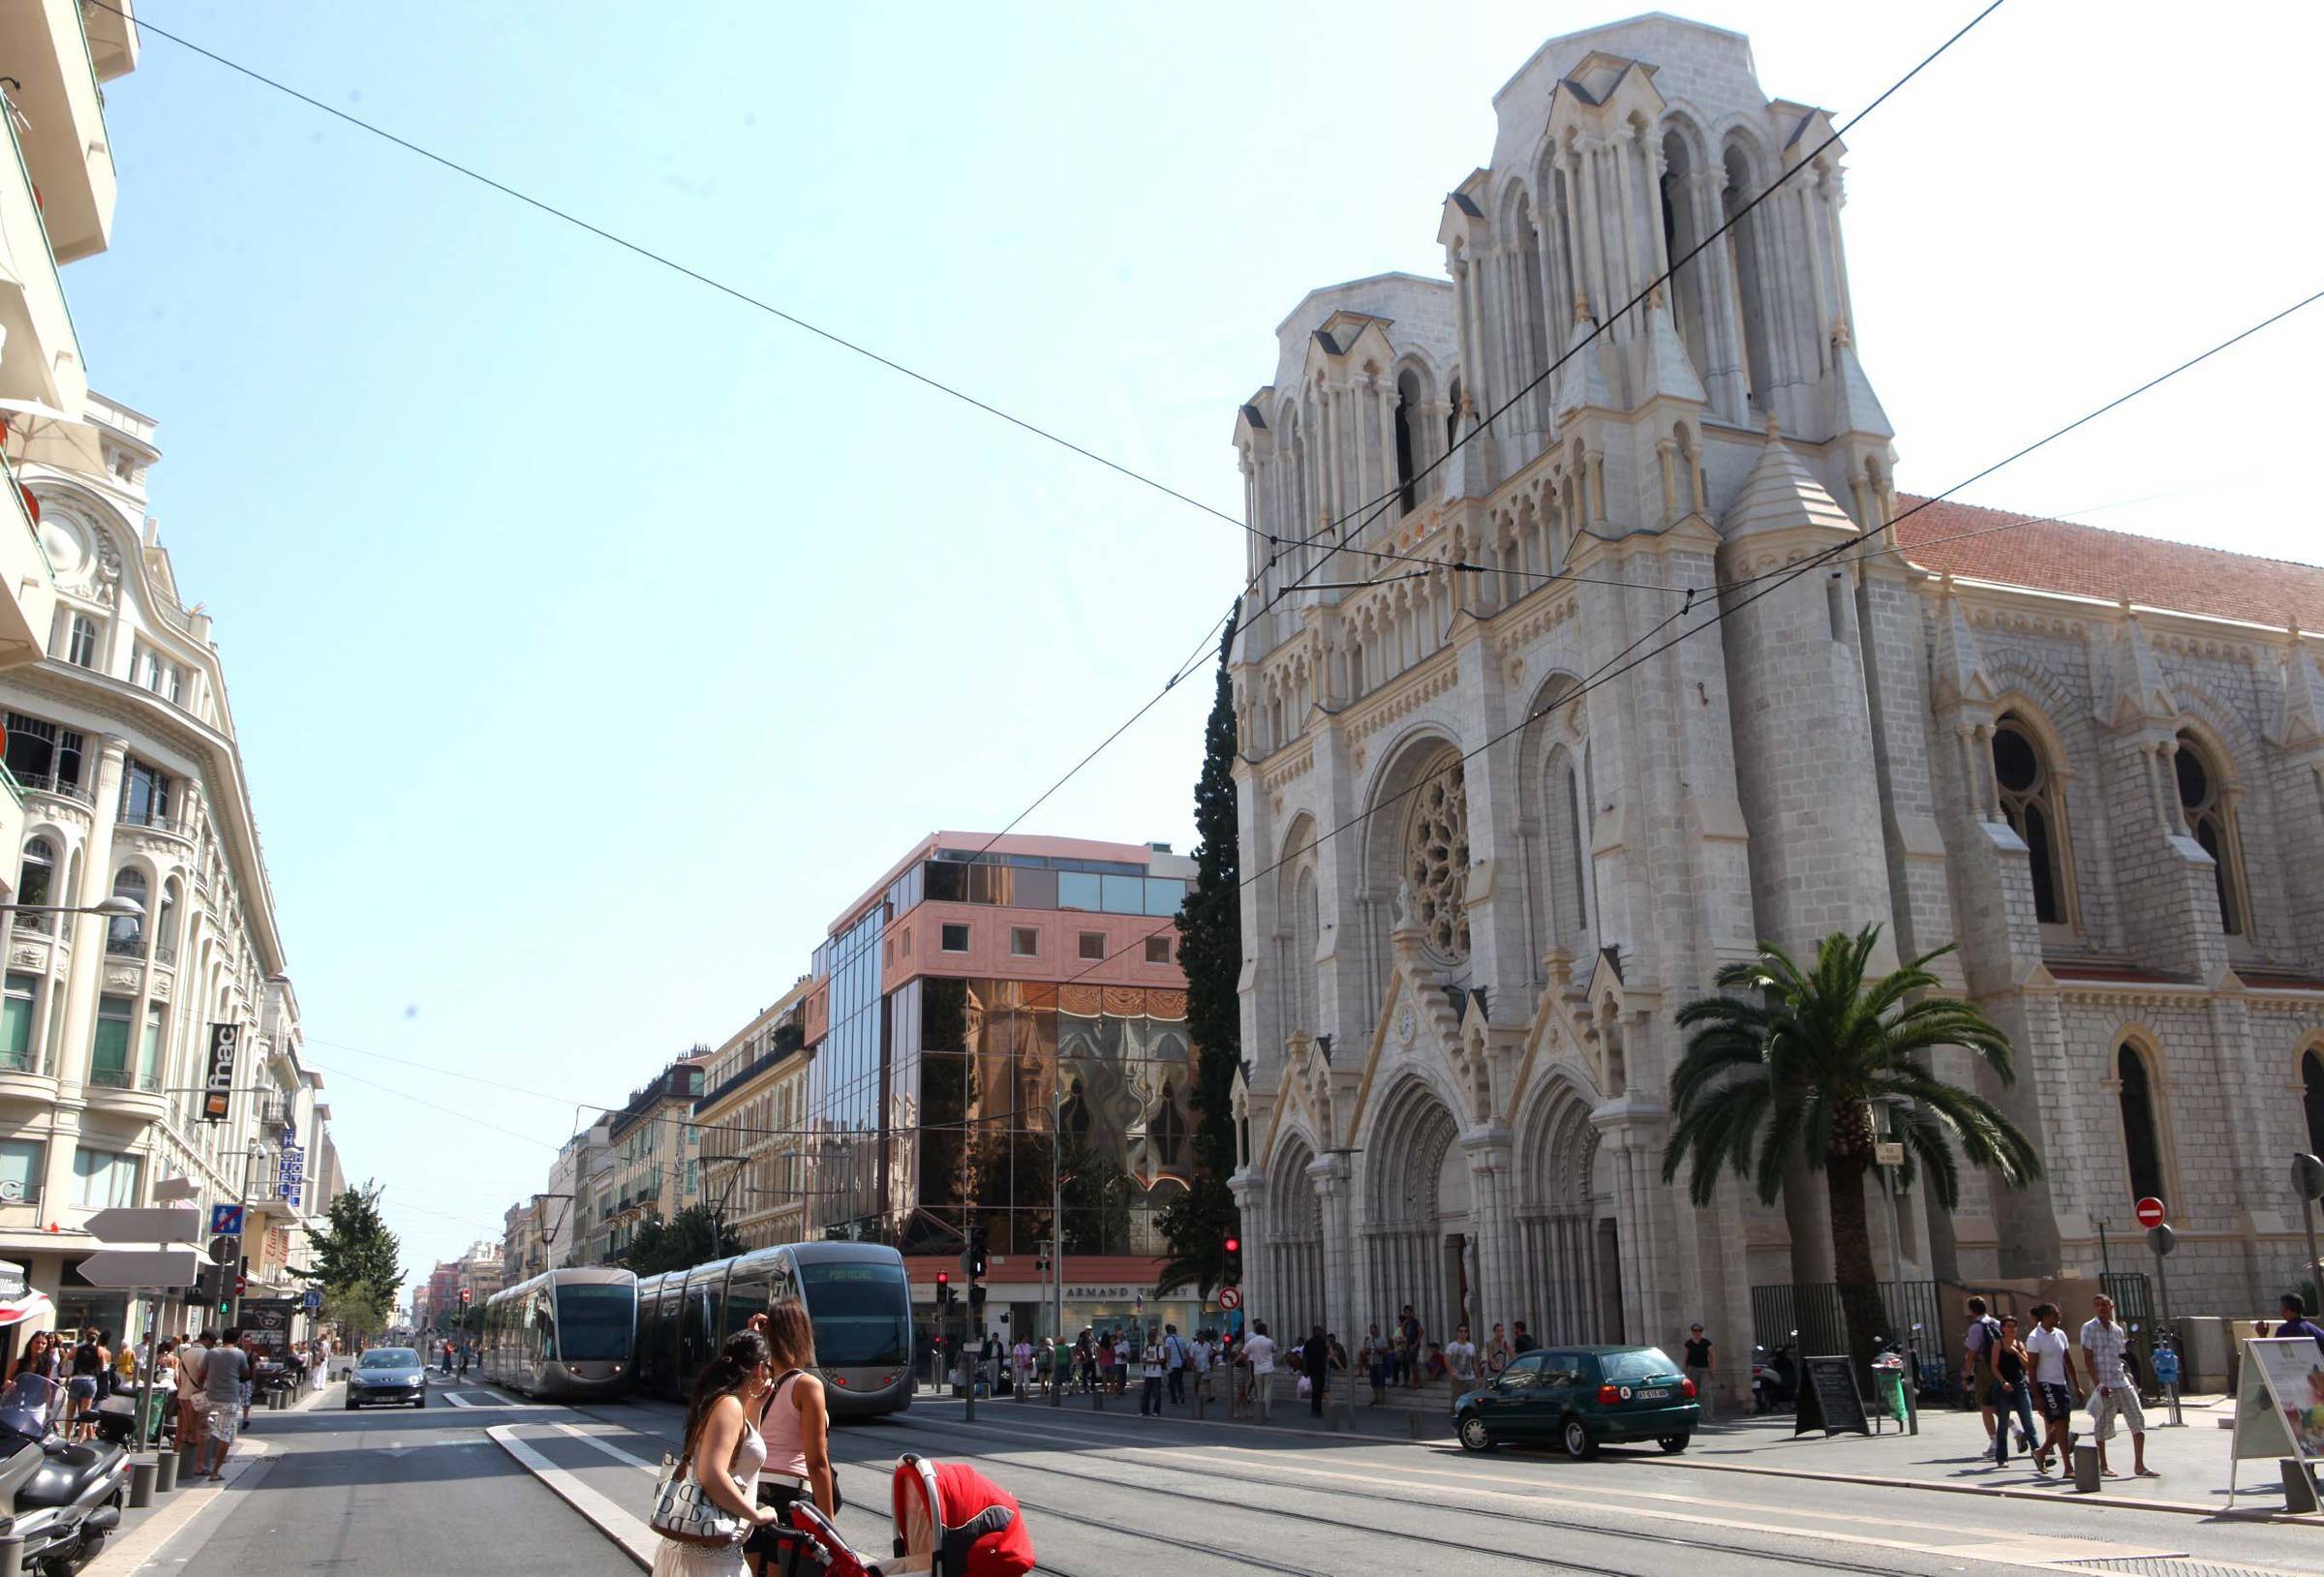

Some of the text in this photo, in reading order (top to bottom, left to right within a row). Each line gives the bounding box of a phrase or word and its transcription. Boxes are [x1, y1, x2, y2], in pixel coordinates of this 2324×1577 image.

[207, 1027, 236, 1092] fnac
[290, 1153, 303, 1207] HOTEL
[1066, 1288, 1129, 1296] ARMAND
